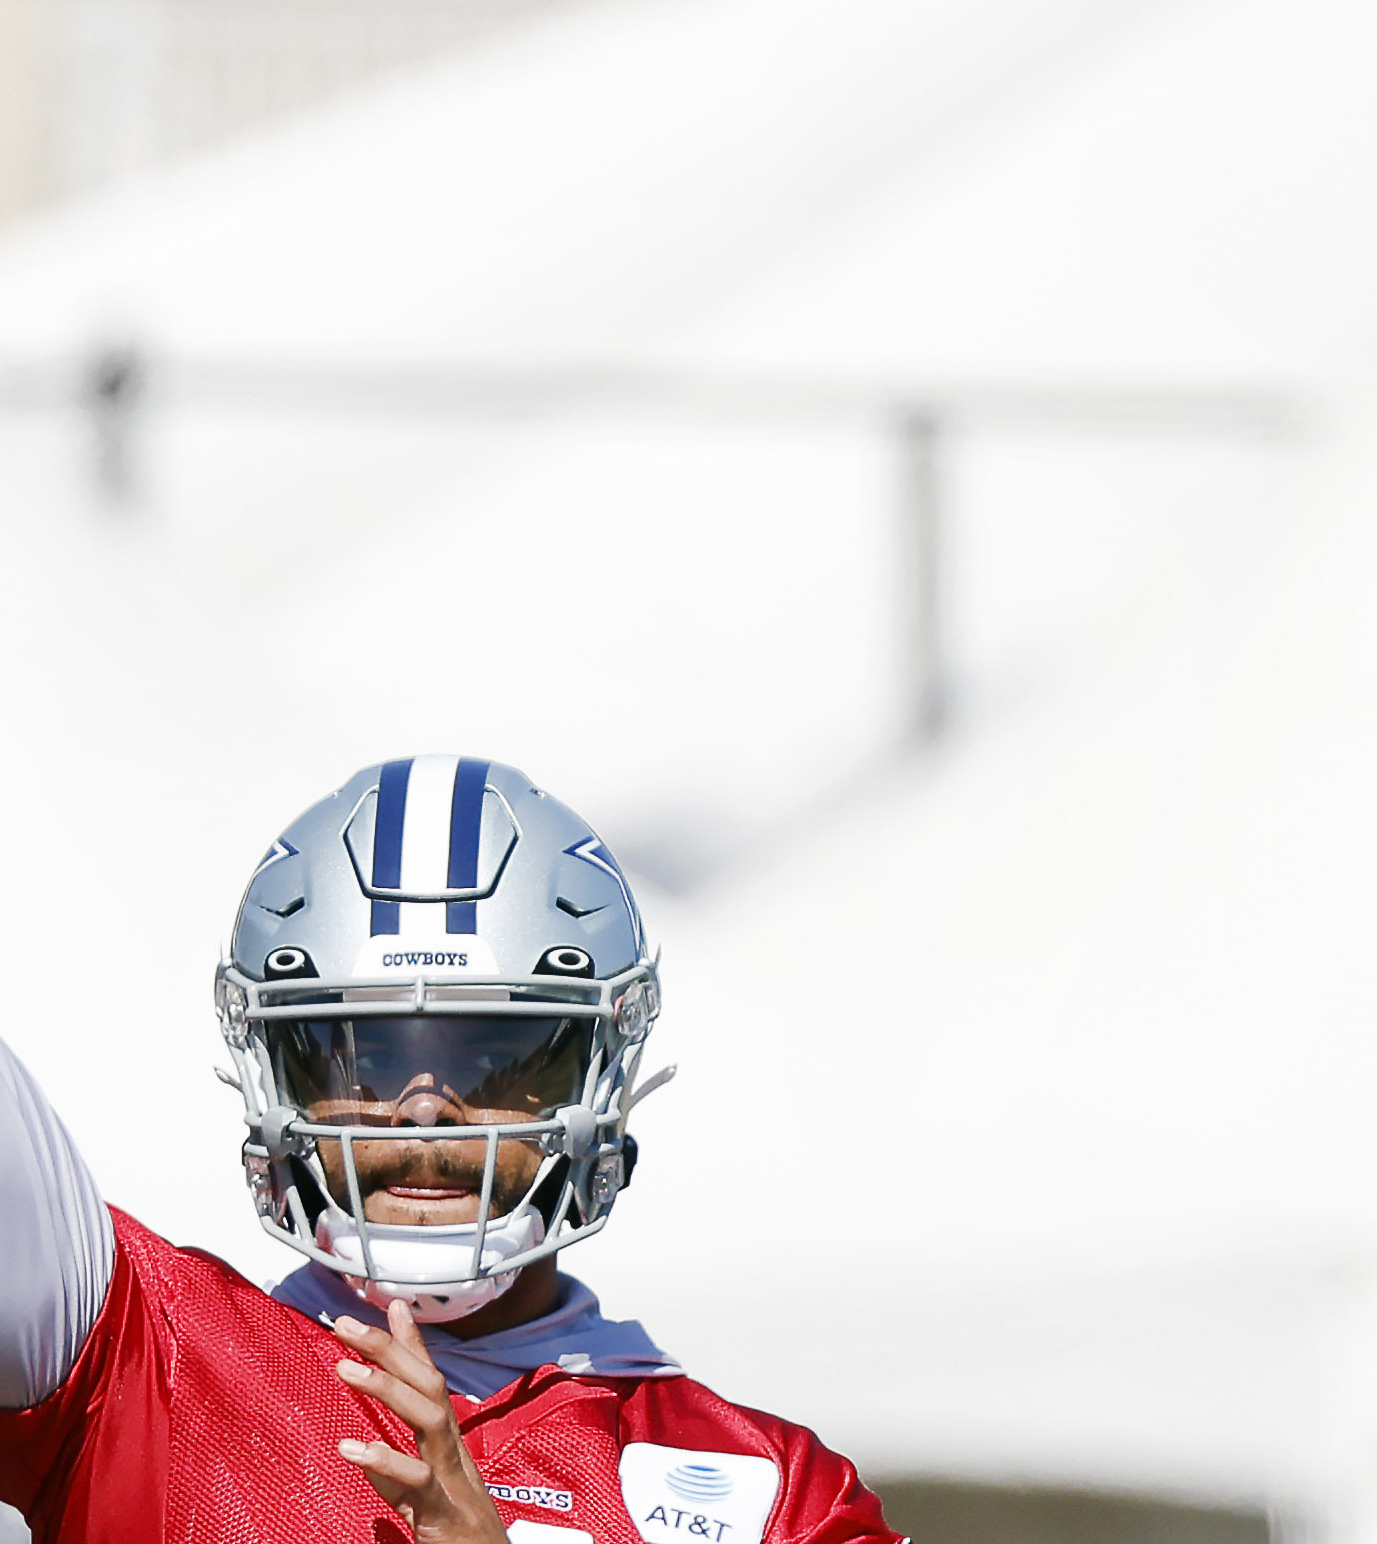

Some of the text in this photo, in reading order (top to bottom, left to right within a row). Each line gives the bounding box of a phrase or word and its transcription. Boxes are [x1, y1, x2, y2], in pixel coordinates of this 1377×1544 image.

[382, 952, 468, 967] COWBOYS
[486, 1485, 569, 1508] BOYS
[644, 1505, 733, 1543] AT&T
